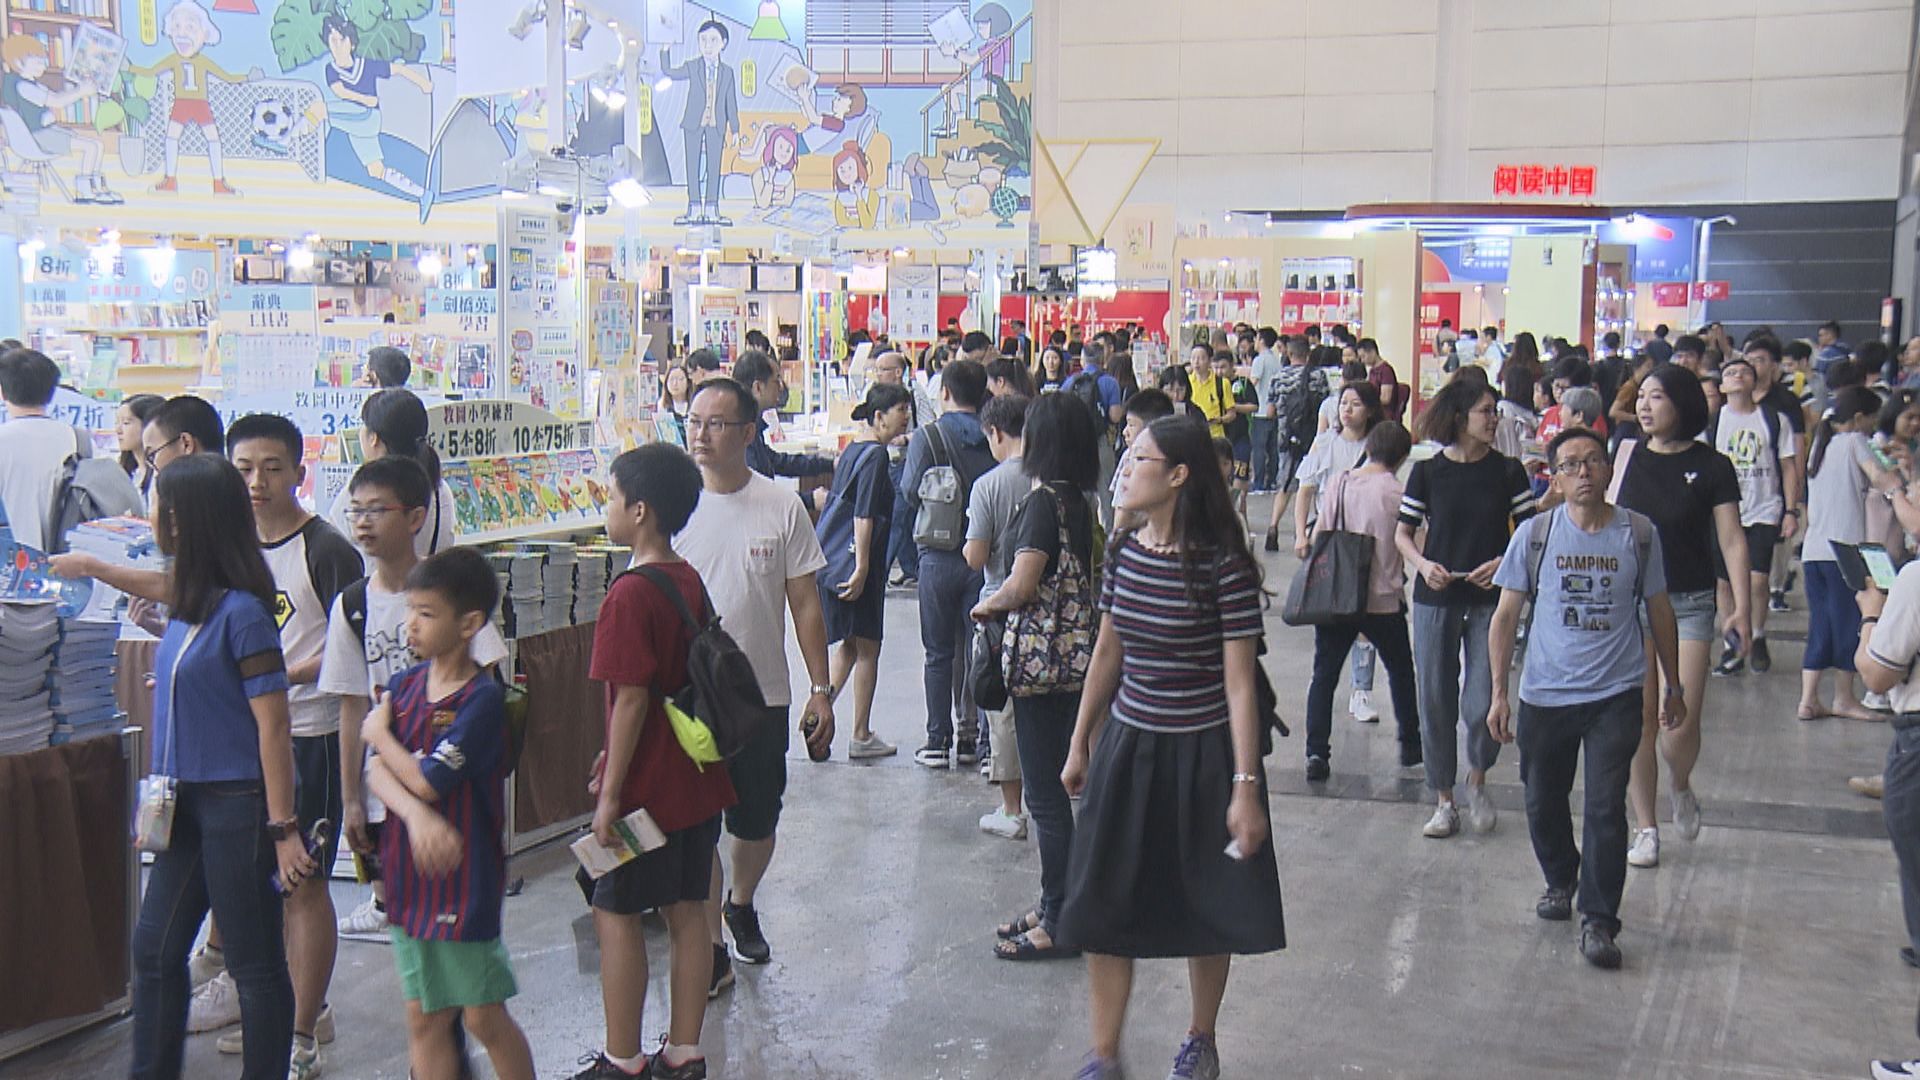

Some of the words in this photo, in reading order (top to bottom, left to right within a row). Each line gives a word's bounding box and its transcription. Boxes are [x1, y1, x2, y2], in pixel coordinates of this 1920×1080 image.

[1494, 165, 1596, 197] 阅读中国
[40, 256, 71, 277] 8折
[1556, 554, 1619, 573] CAMPING
